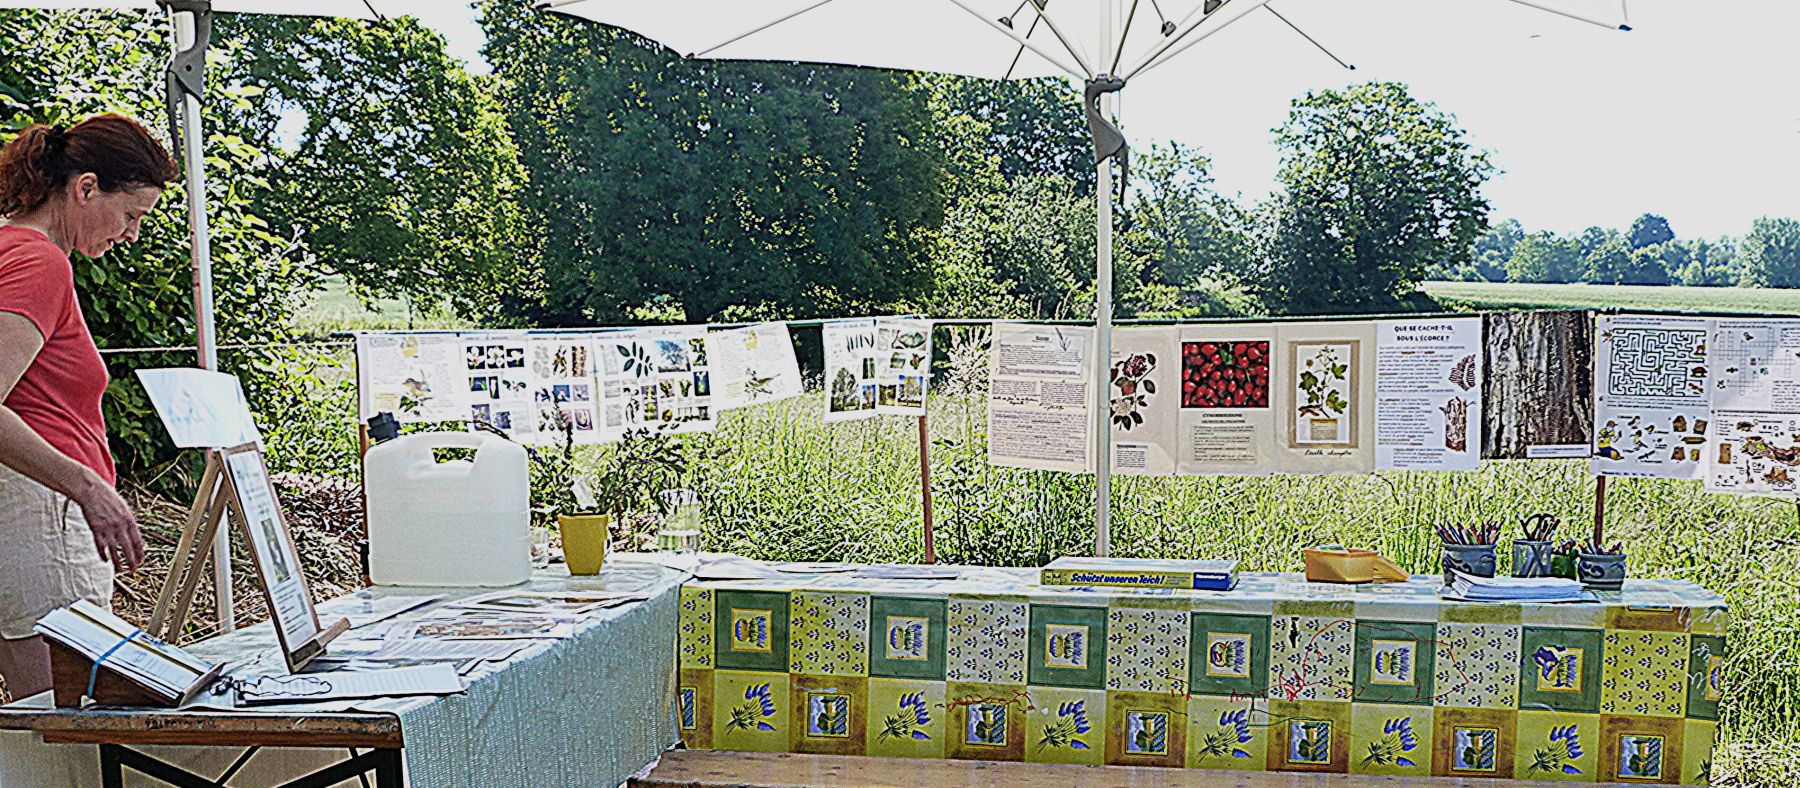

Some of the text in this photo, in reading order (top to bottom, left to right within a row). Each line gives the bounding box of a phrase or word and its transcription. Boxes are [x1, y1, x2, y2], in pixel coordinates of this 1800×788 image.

[1071, 573, 1104, 583] Schützt
[1104, 575, 1138, 584] unseren
[1139, 574, 1165, 584] Teich!
